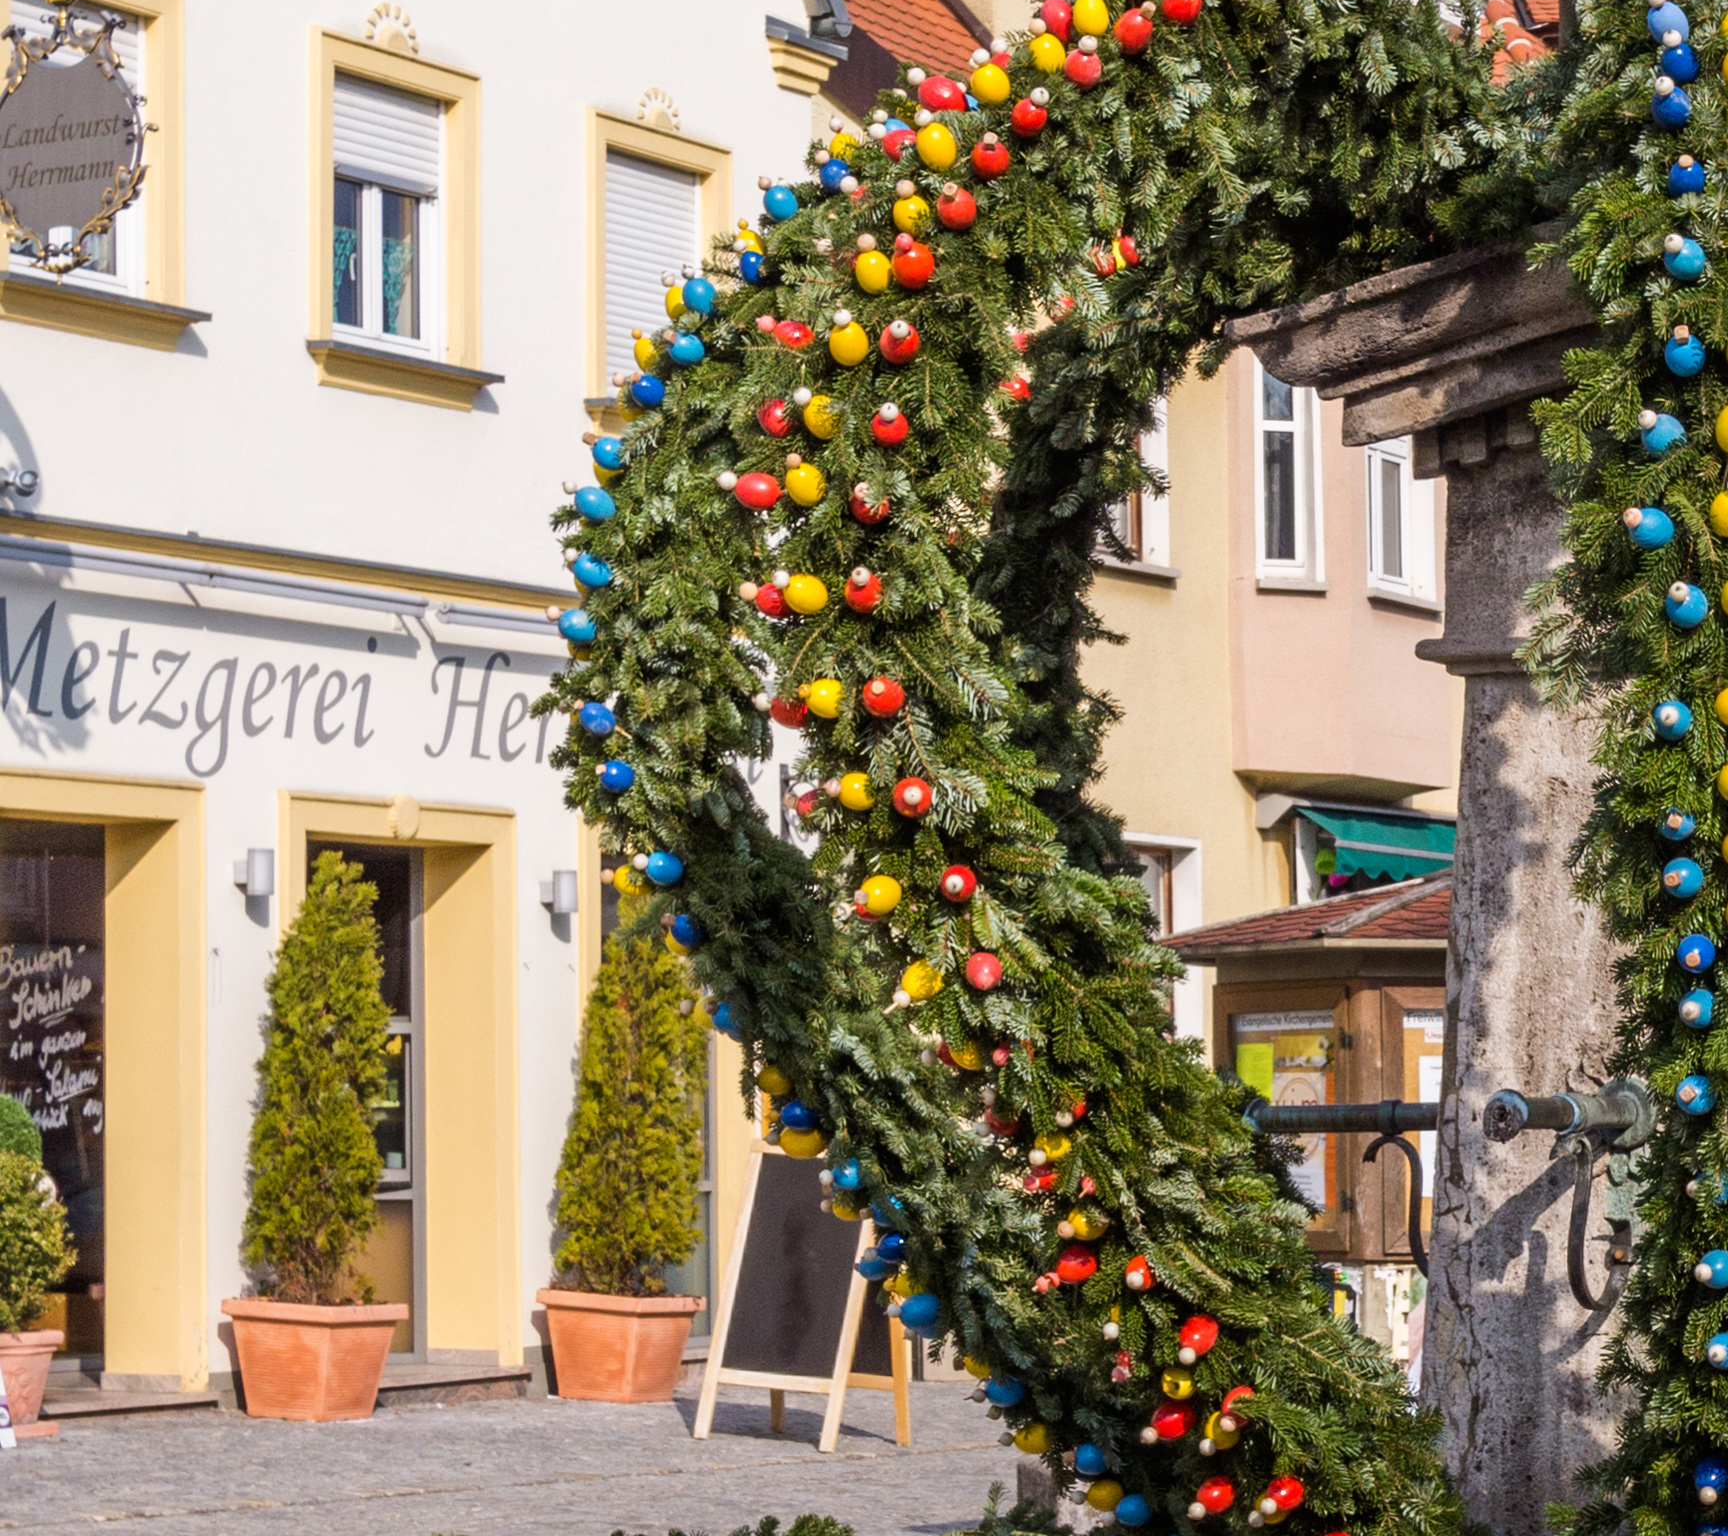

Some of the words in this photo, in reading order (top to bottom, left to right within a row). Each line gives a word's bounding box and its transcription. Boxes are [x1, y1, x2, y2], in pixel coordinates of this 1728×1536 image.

[2, 113, 119, 149] Landwurst
[6, 160, 114, 191] Herrmann
[0, 596, 377, 778] Metzgerei
